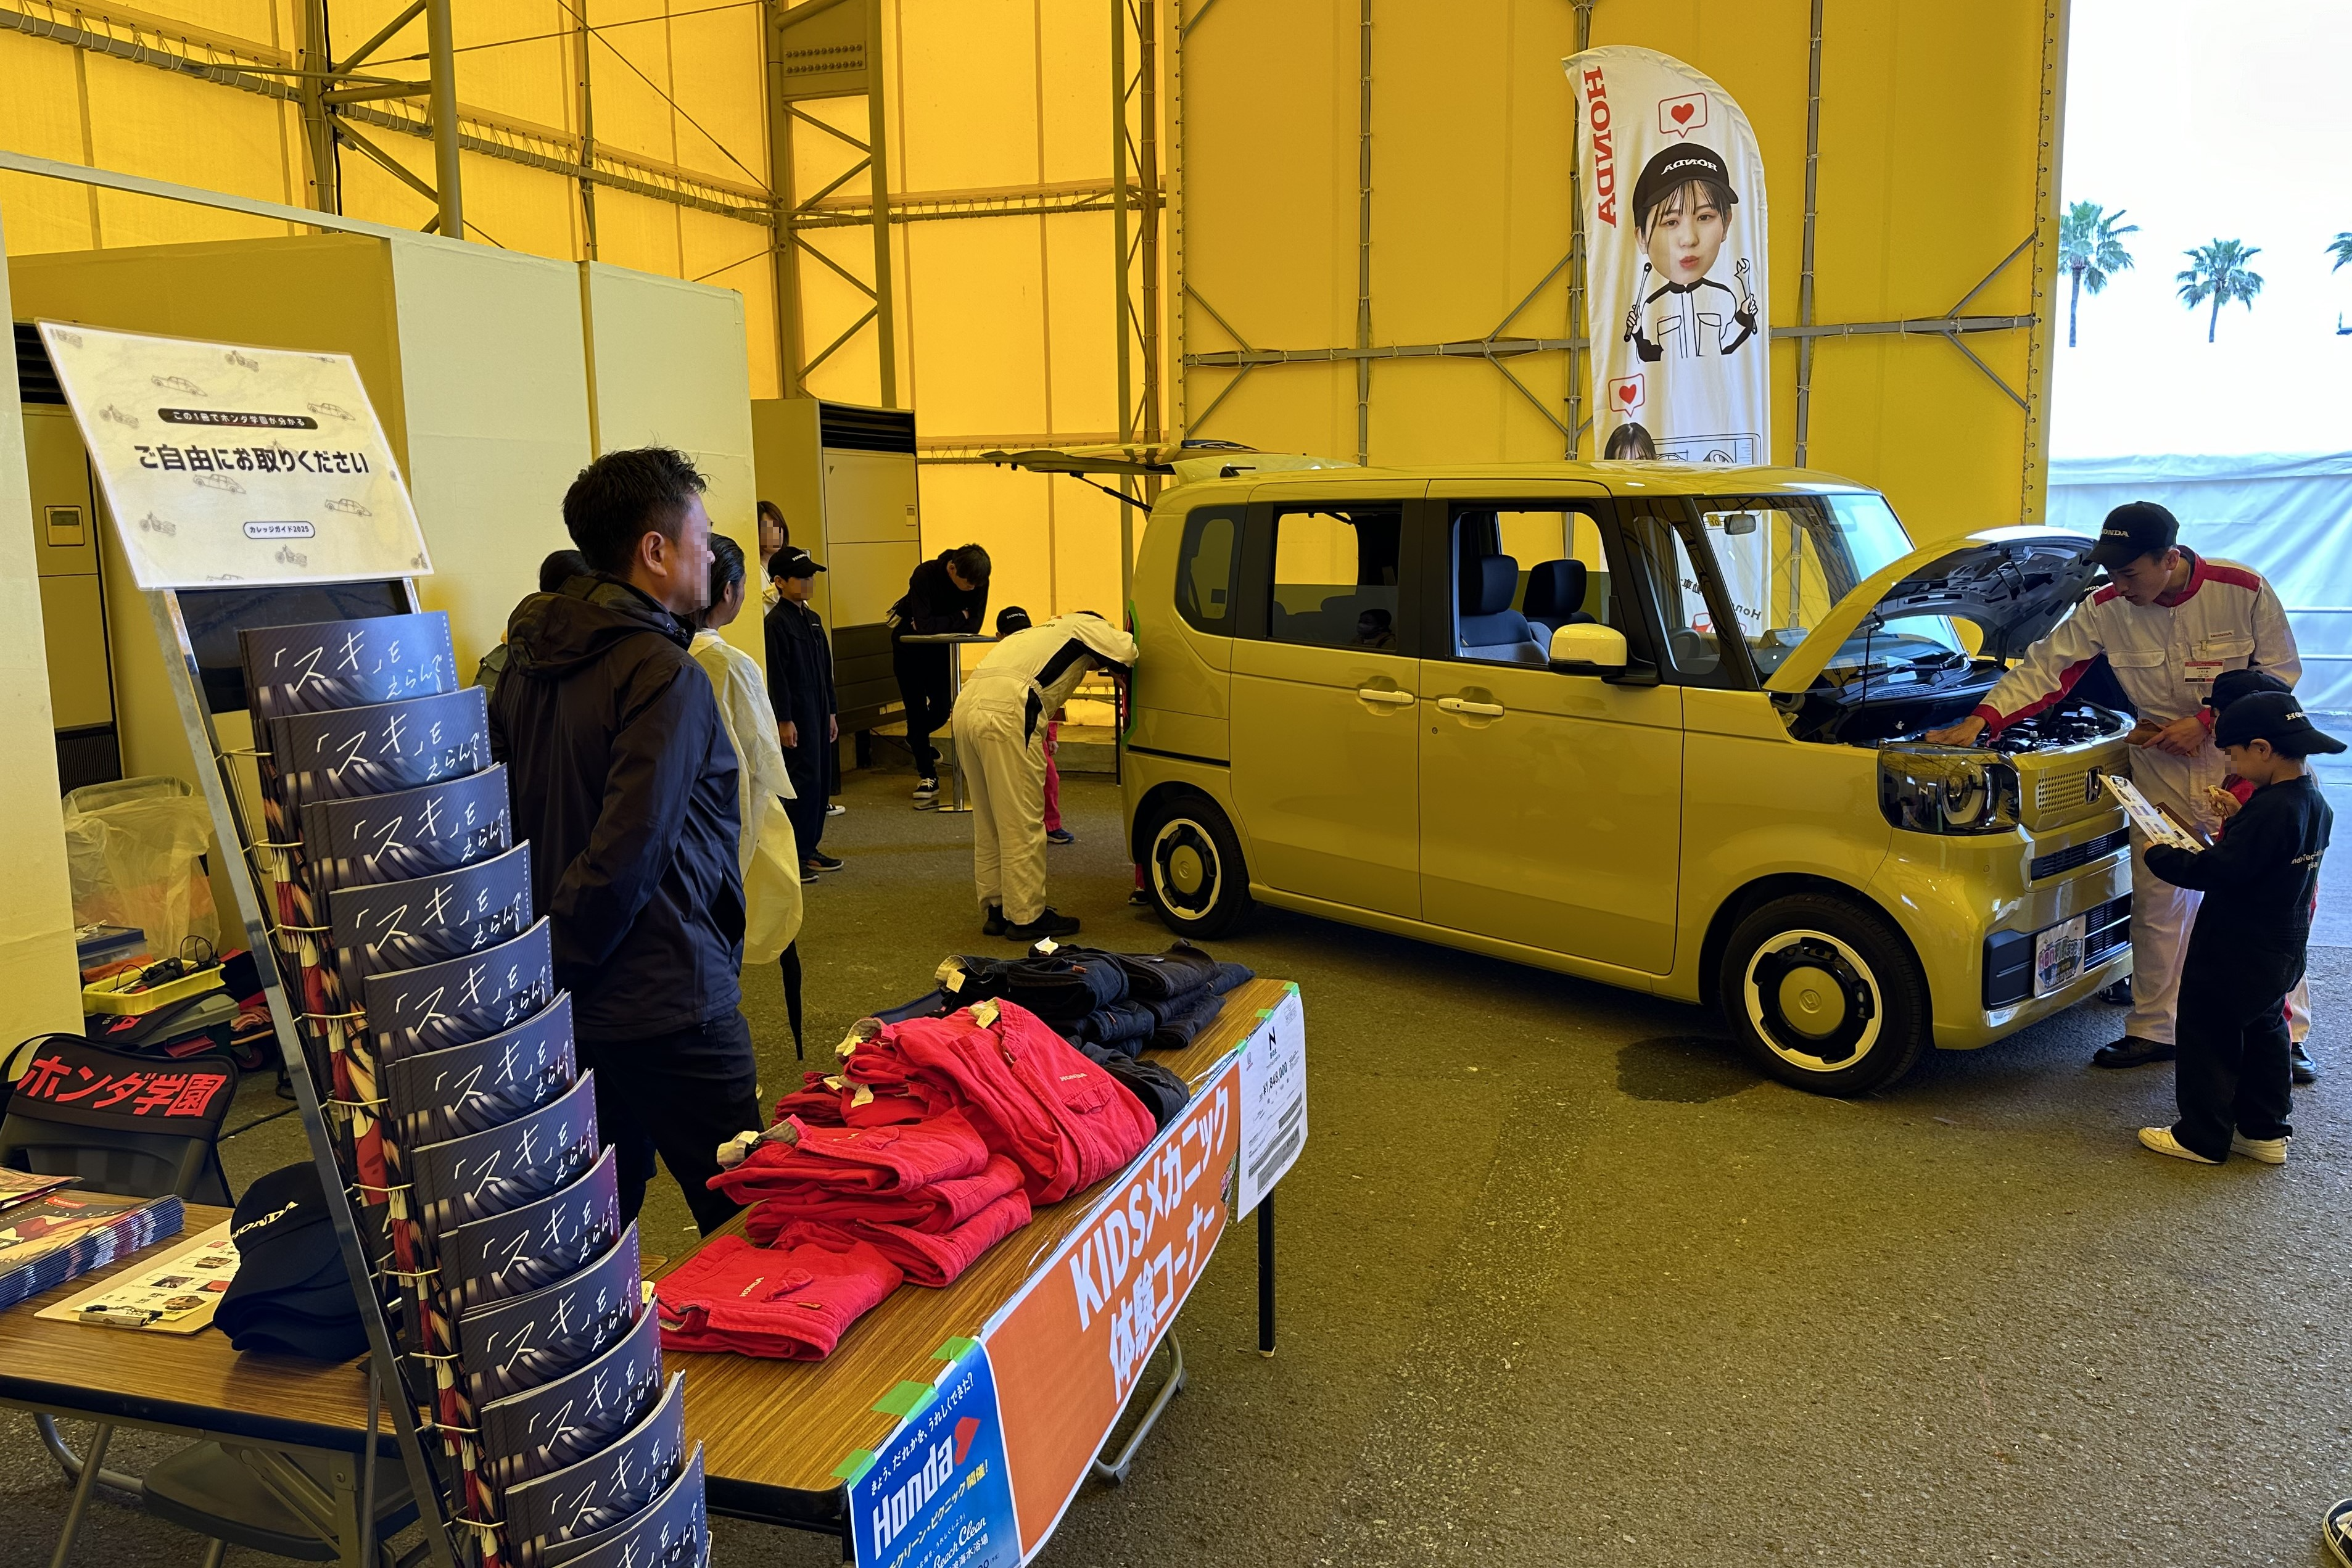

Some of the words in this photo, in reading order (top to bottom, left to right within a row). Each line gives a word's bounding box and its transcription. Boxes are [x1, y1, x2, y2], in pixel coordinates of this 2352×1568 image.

[173, 411, 305, 427] この1冊でホンダ学園が分かる
[134, 443, 369, 474] ご自由にお取りください
[249, 526, 310, 534] カレッジガイド2025
[1268, 1026, 1277, 1051] N
[17, 1055, 227, 1117] ホンダ学園
[1059, 1072, 1087, 1083] HONDA
[1070, 1085, 1229, 1332] KIDSメカニック
[739, 1276, 765, 1298] HONDA
[1109, 1201, 1215, 1405] 体験コーナー
[872, 1434, 954, 1561] Honda
[958, 1517, 987, 1546] Clean
